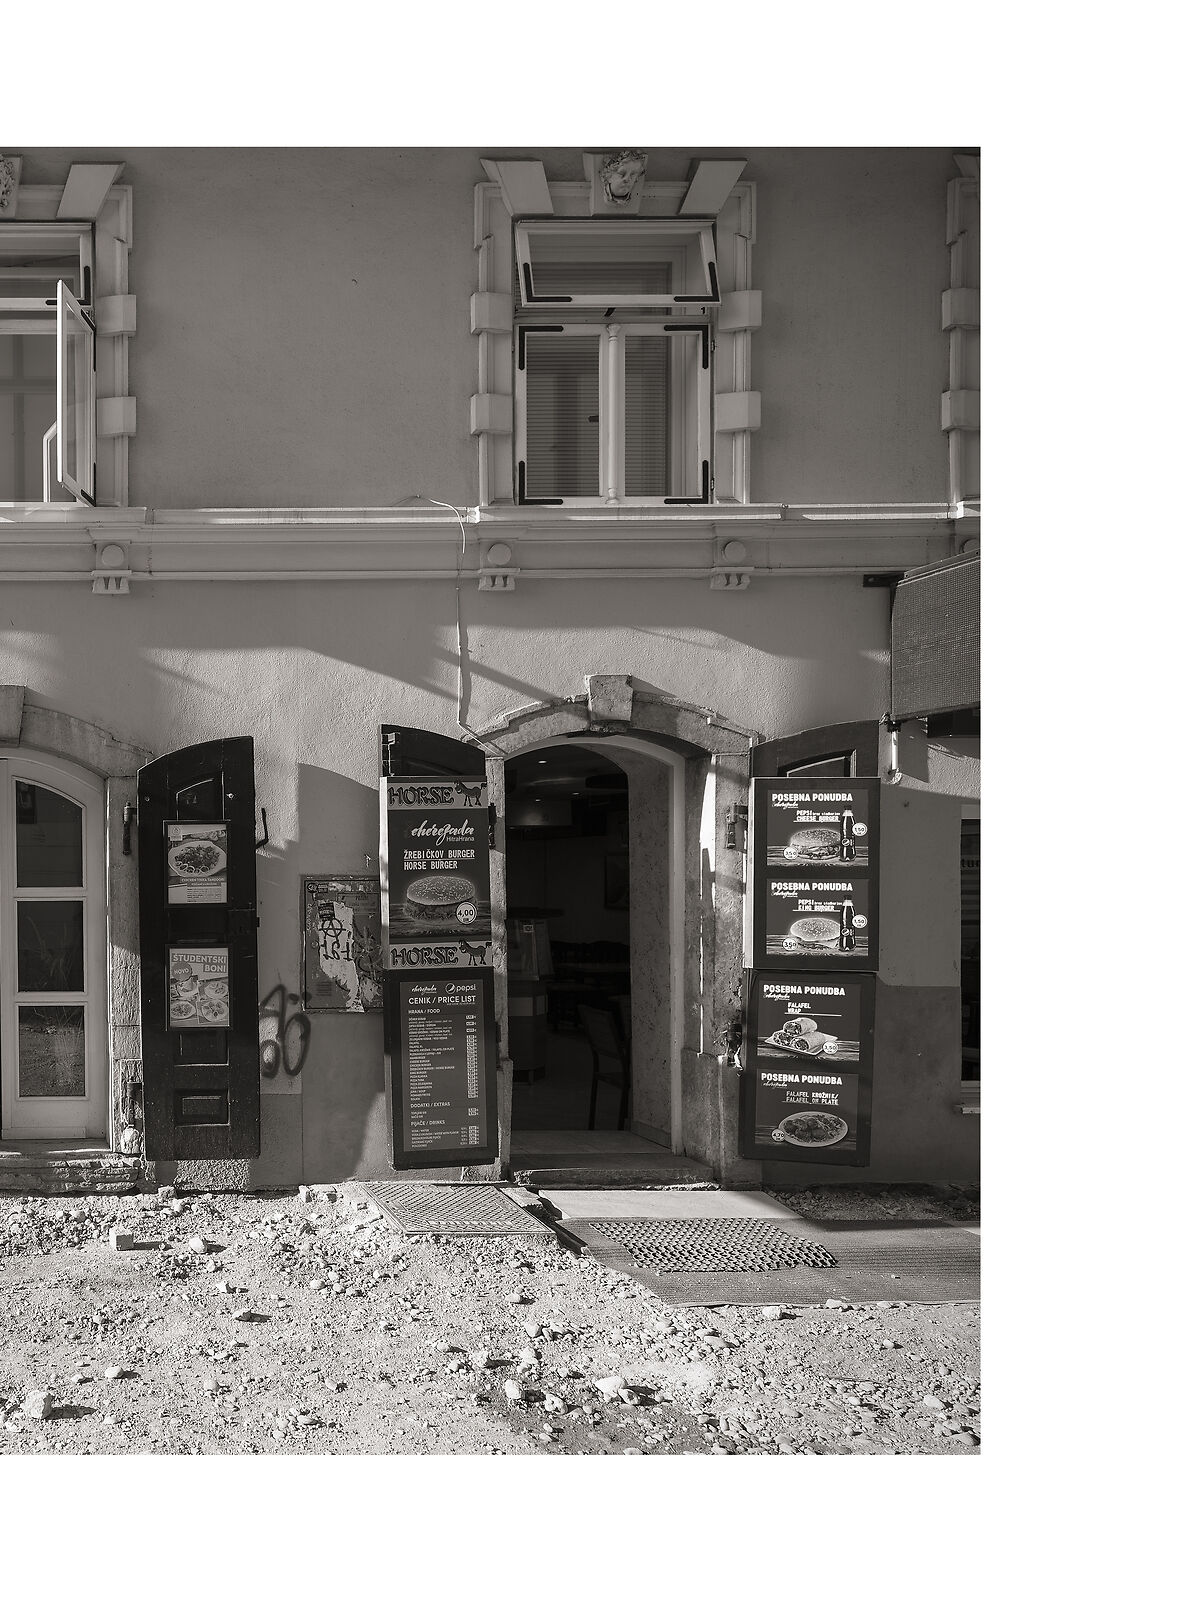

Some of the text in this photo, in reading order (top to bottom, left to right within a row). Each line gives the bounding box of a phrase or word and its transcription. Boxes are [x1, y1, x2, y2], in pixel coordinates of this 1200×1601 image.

[387, 786, 455, 806] HORSE
[772, 793, 853, 801] POSEBNA PONUDBA
[403, 849, 475, 859] ŽREBIČKOV BURGER
[403, 861, 458, 870] HORSE BURGER
[771, 882, 853, 891] POSEBNA PONUDBA
[457, 909, 474, 918] 4,00
[173, 954, 227, 964] STUDENTSKI
[390, 946, 459, 967] HORSE
[204, 964, 226, 972] BONI
[456, 984, 476, 992] pepsi
[763, 984, 845, 996] POSEBNA PONUDBA
[408, 997, 431, 1005] CENIK
[437, 996, 460, 1004] PRICE
[461, 995, 476, 1003] LIST
[761, 1072, 843, 1085] POSEBNA PONUDBA
[786, 1090, 809, 1098] FALAFEL
